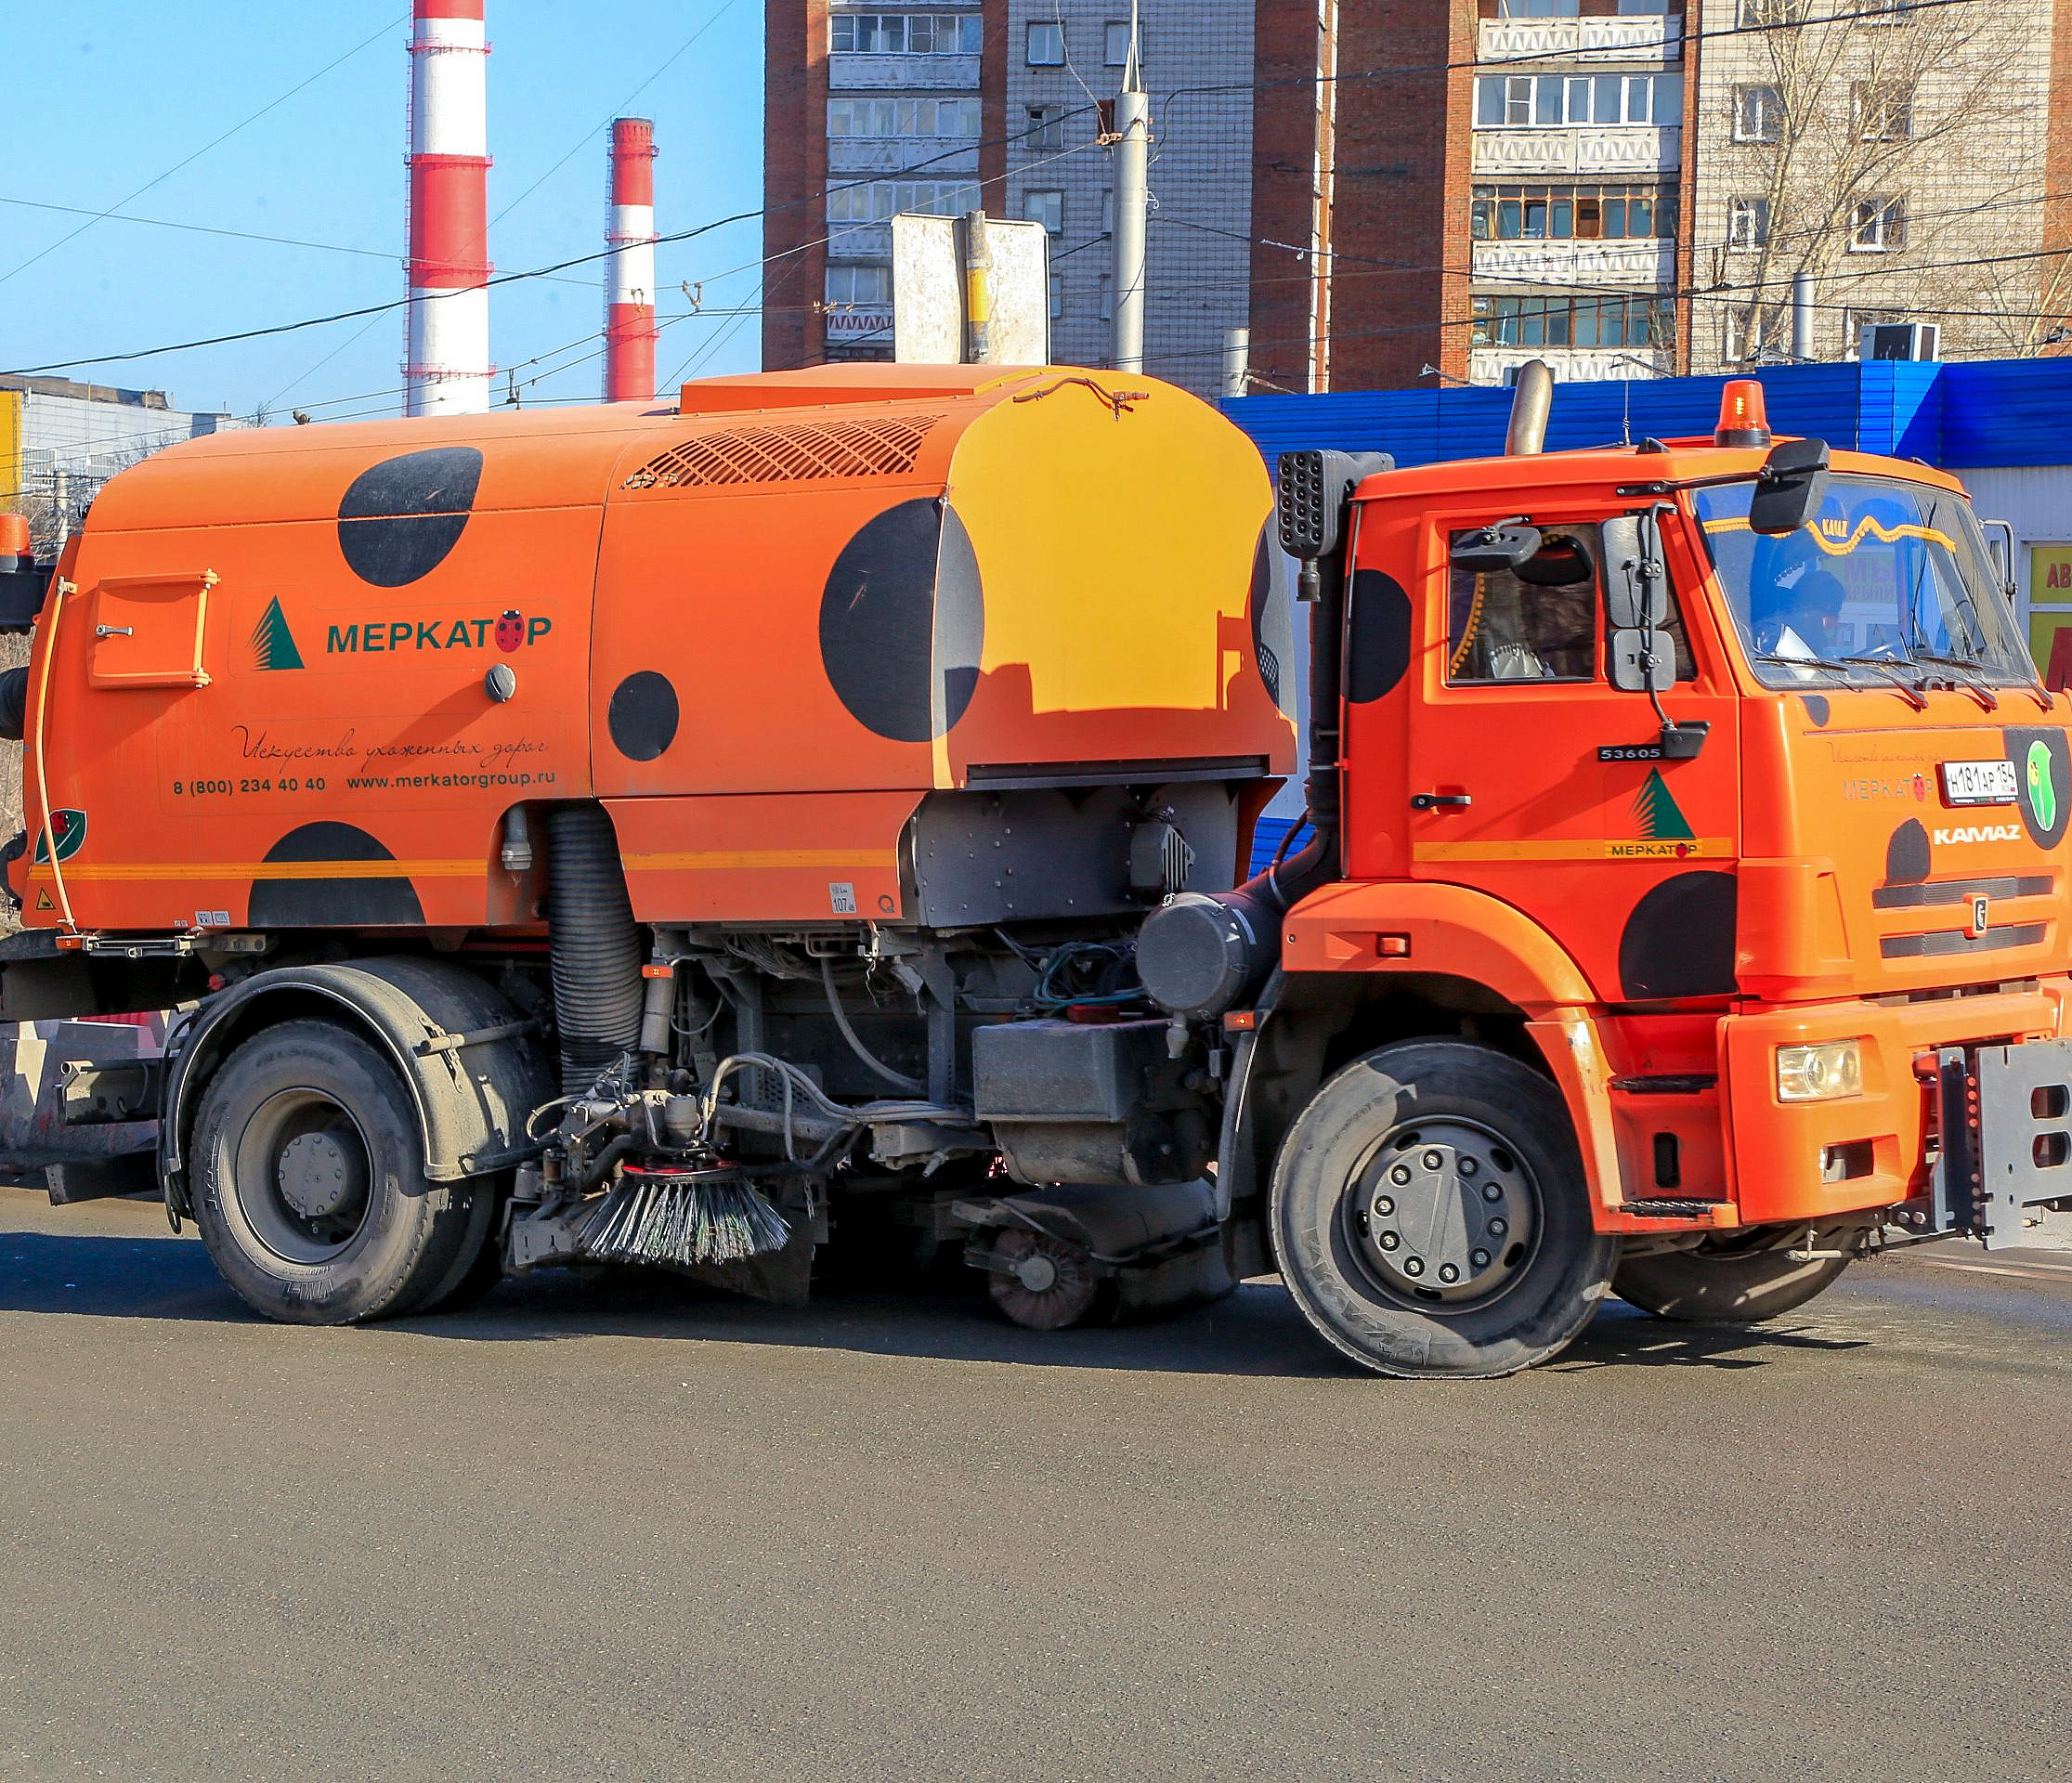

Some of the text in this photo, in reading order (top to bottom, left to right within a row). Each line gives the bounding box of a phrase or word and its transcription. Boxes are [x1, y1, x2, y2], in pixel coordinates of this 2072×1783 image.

[1600, 748, 1662, 761] 53605
[174, 771, 556, 798] 8 (800) 234 40 40 www.merkatorgroup.ru
[1933, 824, 2022, 846] KAMAZ
[833, 897, 848, 912] 107
